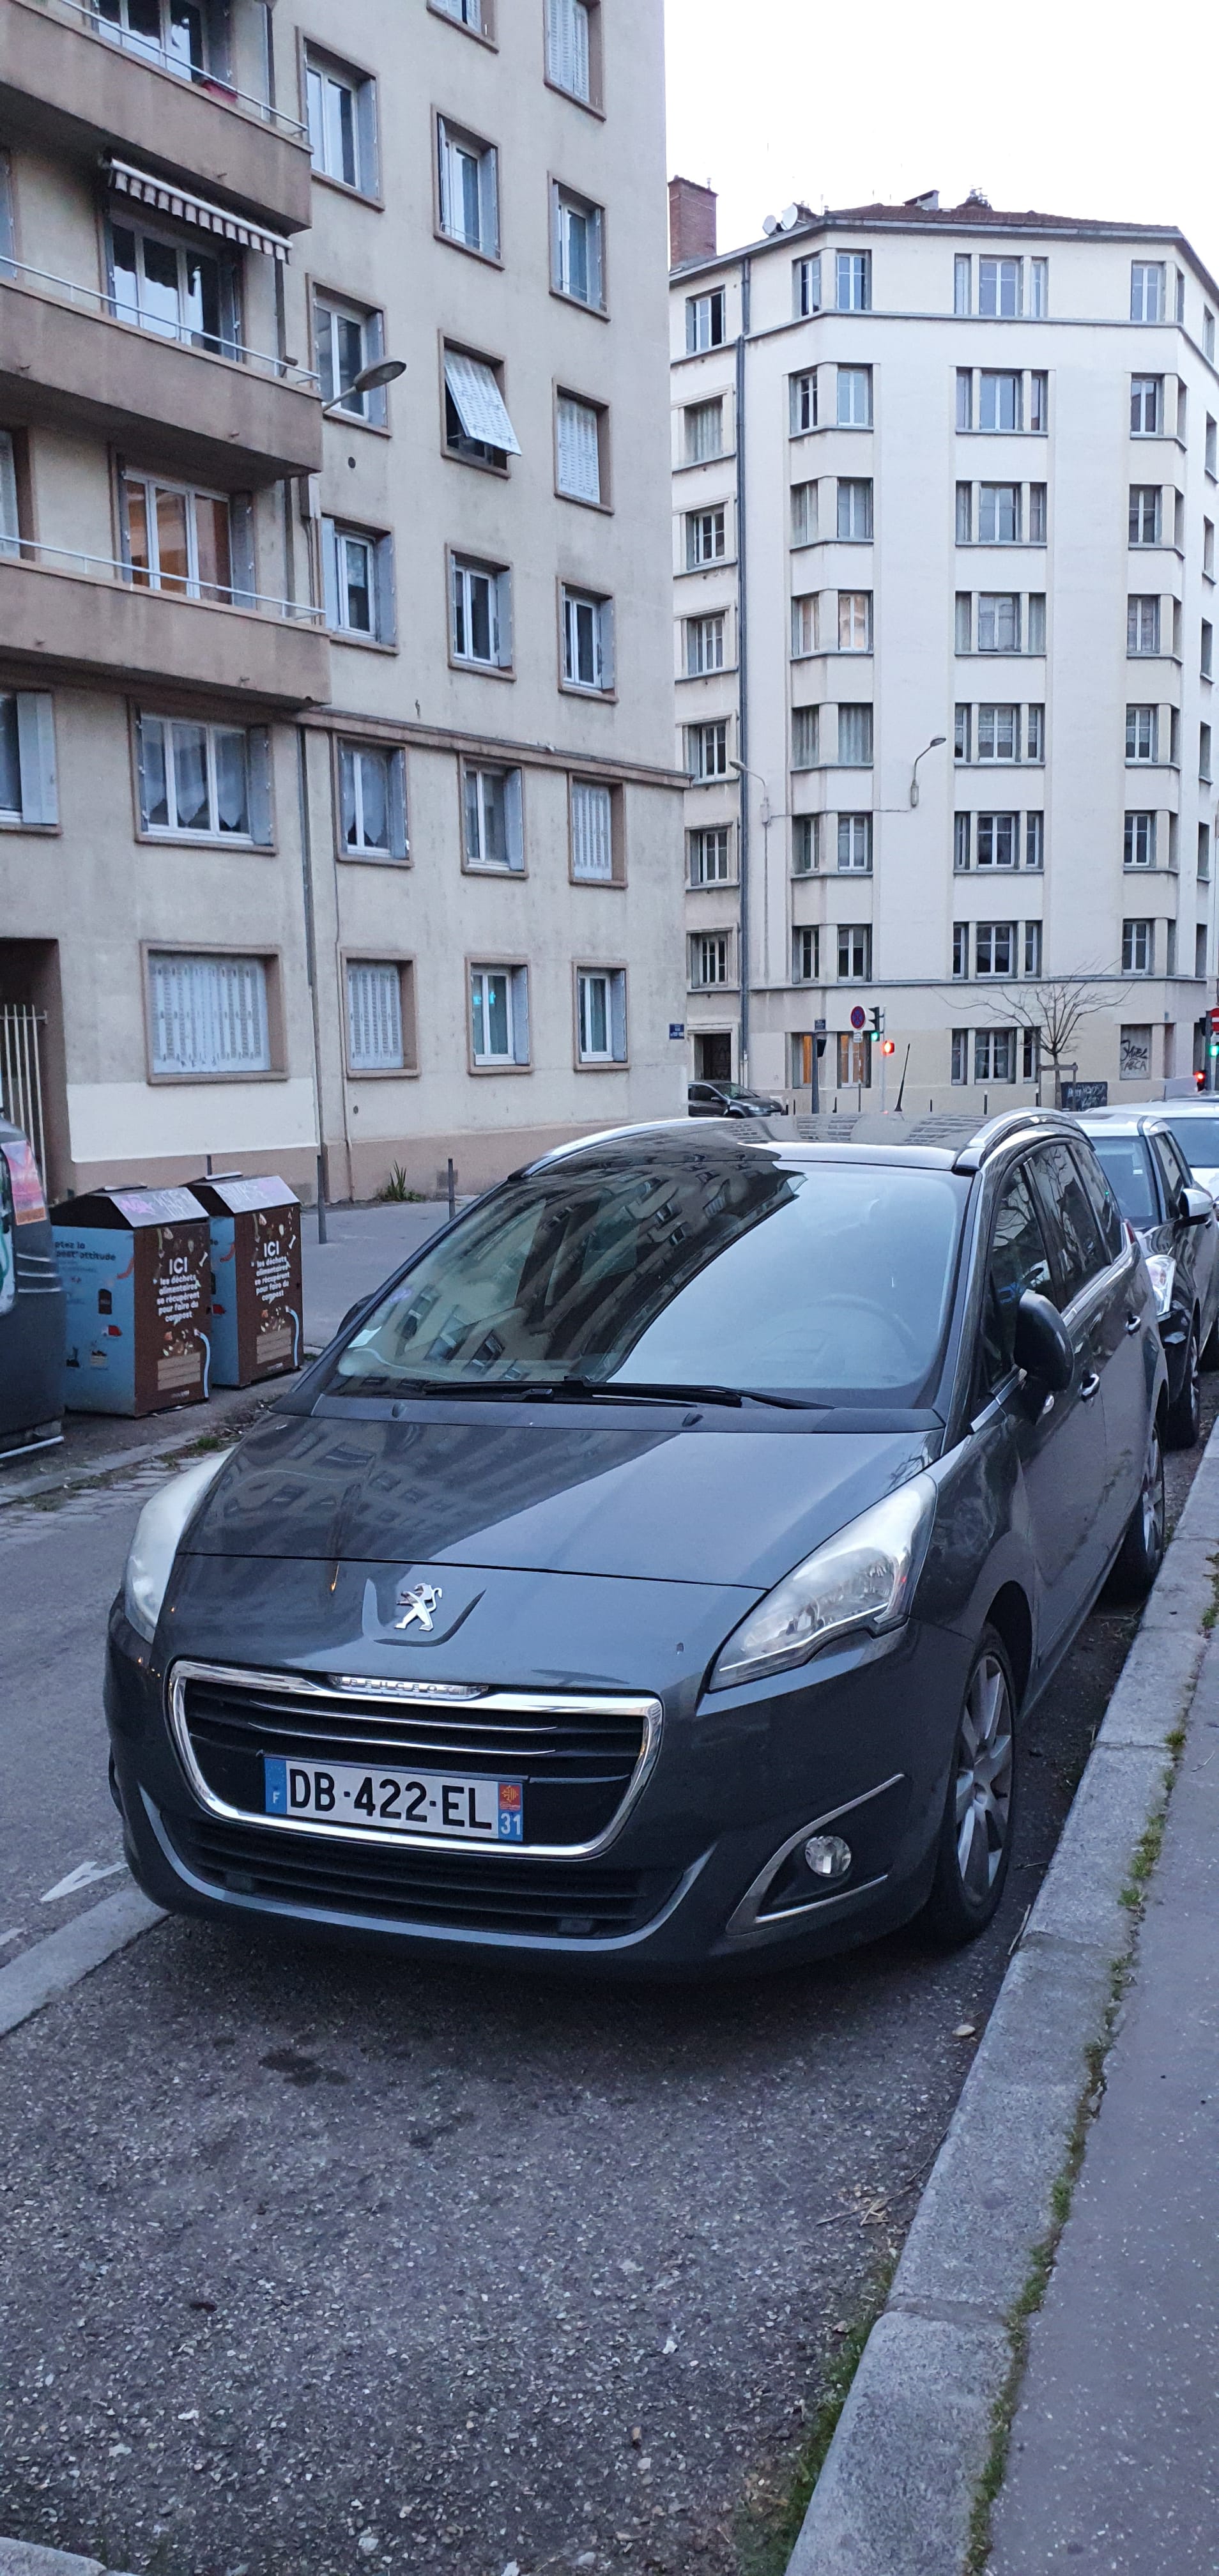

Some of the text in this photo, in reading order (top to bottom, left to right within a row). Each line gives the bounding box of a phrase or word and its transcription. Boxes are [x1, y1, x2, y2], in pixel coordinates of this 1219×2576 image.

[263, 1240, 280, 1258] ICI
[169, 1256, 188, 1275] ICI
[160, 1274, 196, 1285] les déchets
[158, 1283, 198, 1296] alimentaires
[158, 1300, 199, 1317] pour faire du
[165, 1310, 193, 1324] compost
[349, 1678, 453, 1694] PEUGEOT
[273, 1790, 280, 1804] F
[289, 1768, 492, 1830] DB-422-EL
[500, 1813, 521, 1835] 31
